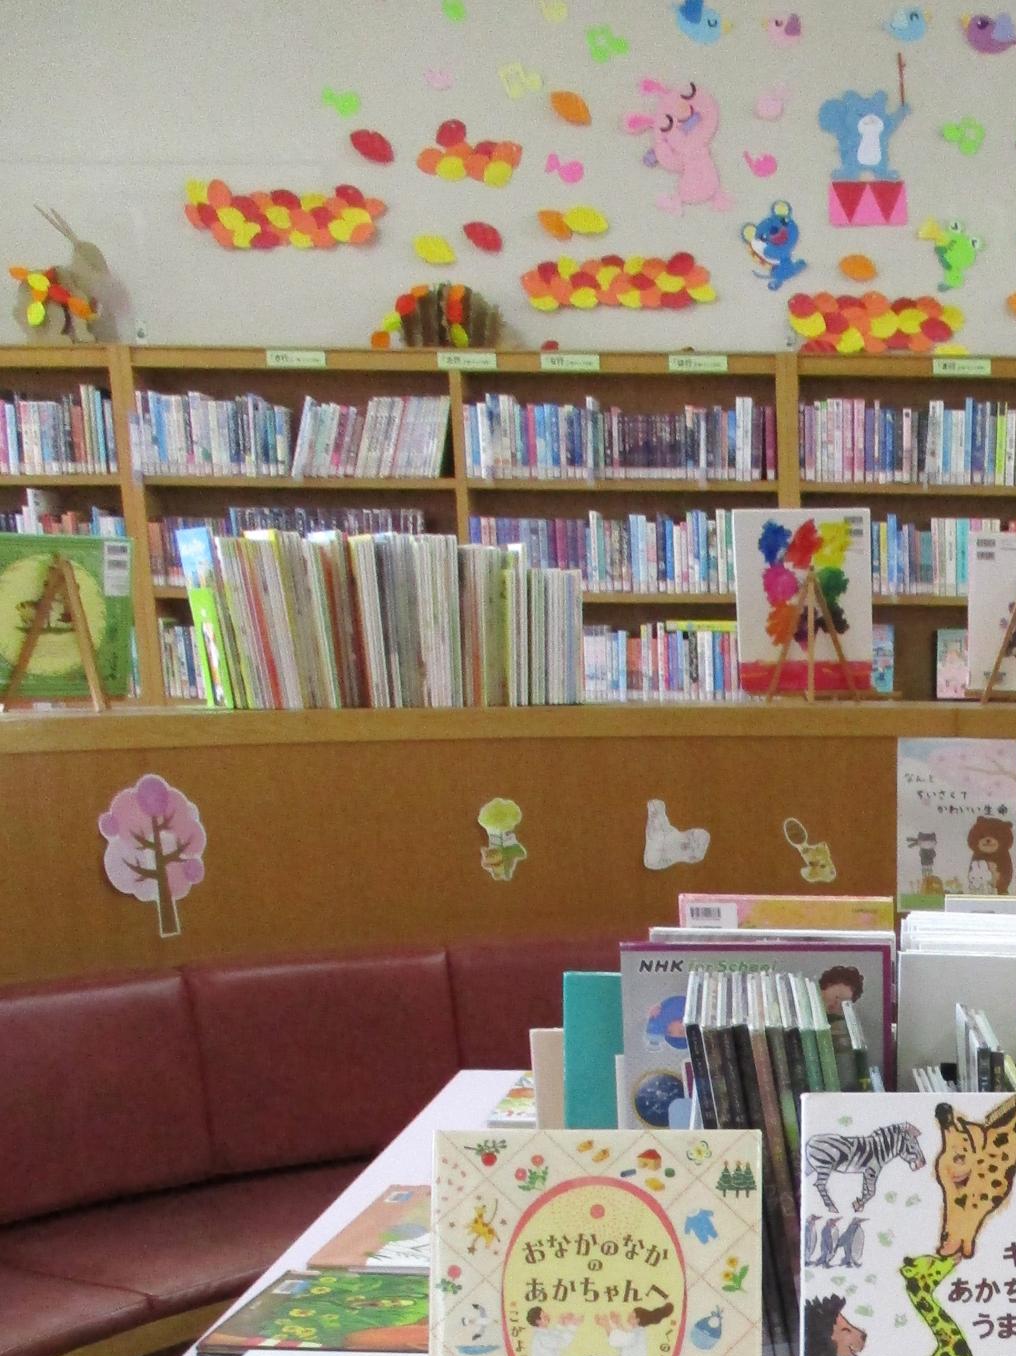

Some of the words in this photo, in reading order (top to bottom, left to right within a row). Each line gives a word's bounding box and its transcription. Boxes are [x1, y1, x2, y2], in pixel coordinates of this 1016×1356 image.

[904, 773, 935, 783] なんと
[916, 790, 967, 800] ちいさくて
[937, 804, 1008, 816] かわいい生命
[639, 960, 684, 972] NHK
[522, 1233, 669, 1268] おなかのなか
[588, 1258, 603, 1272] の
[524, 1277, 670, 1302] あかちゃんへ
